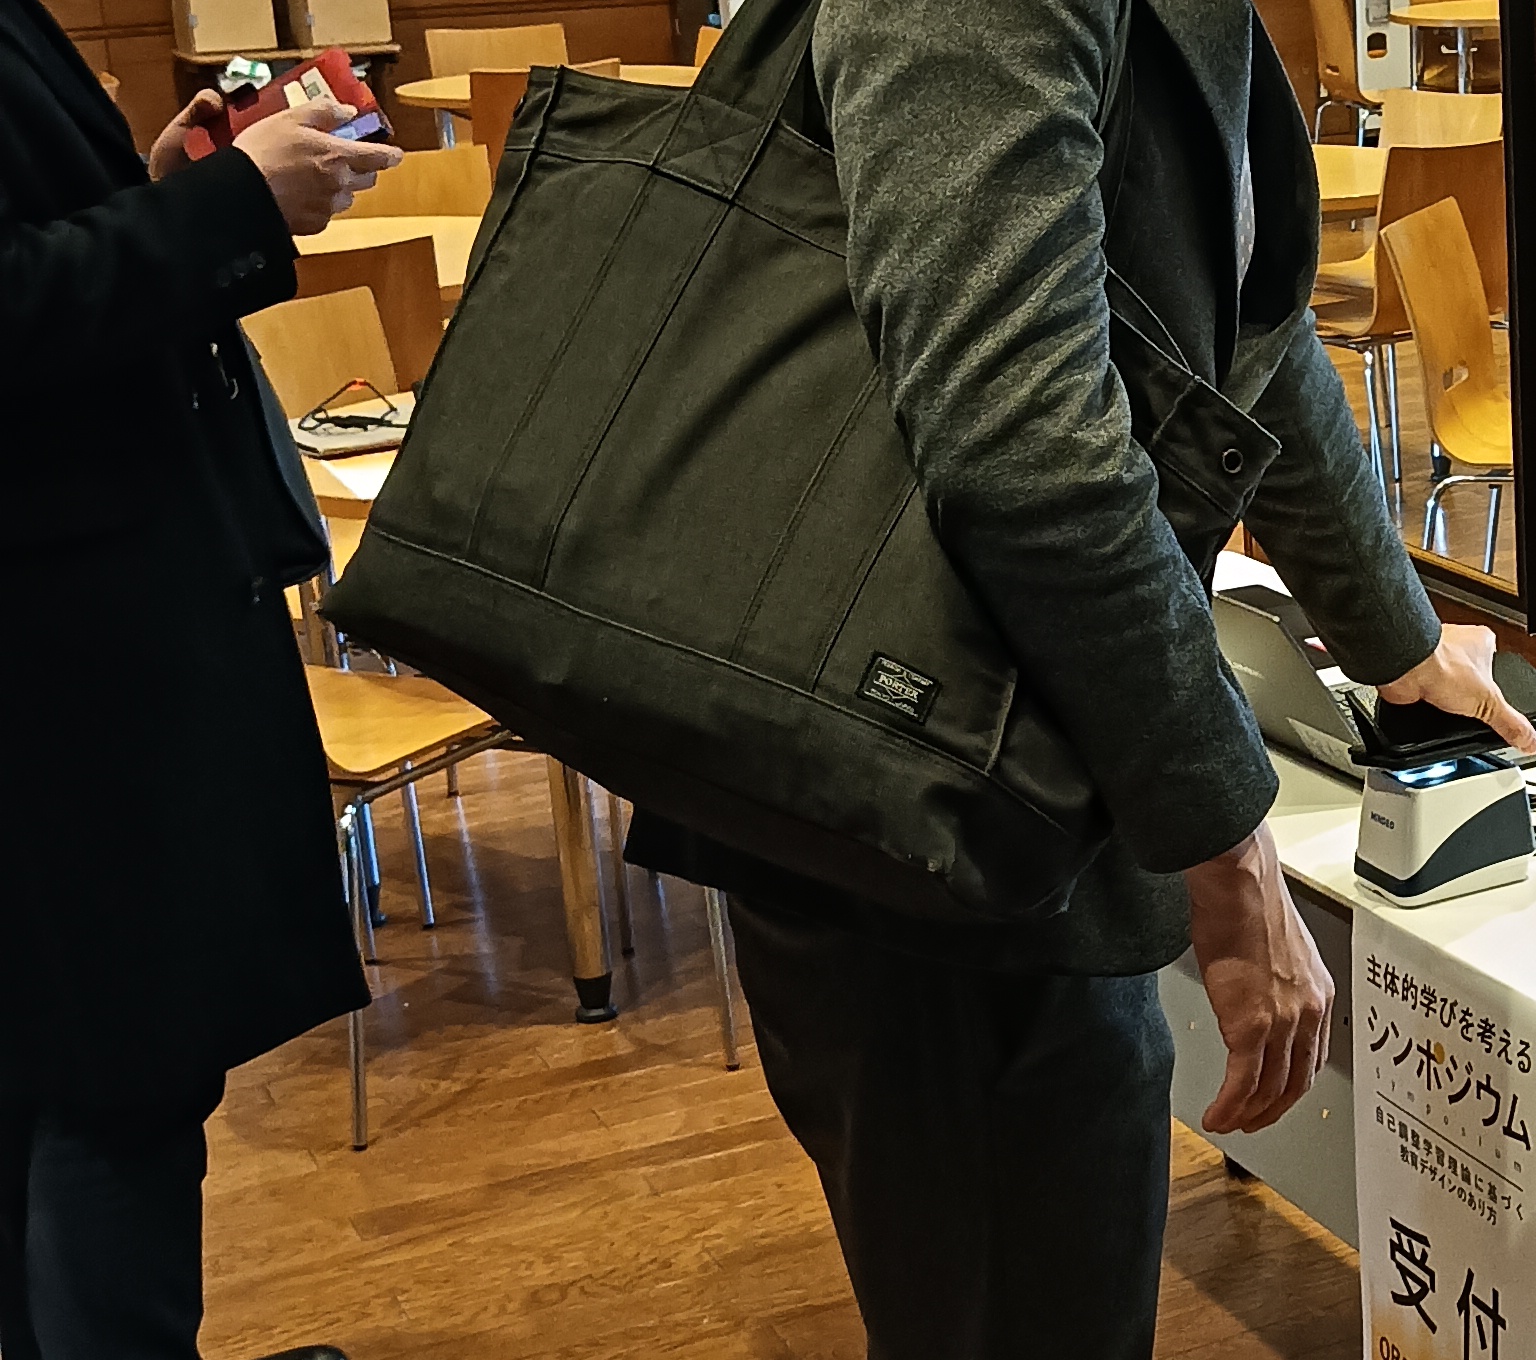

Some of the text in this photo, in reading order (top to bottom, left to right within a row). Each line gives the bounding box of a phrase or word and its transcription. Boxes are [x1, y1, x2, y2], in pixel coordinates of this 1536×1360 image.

[879, 674, 919, 700] PORTER
[1366, 953, 1532, 1074] 主体的学びを考える
[1367, 1005, 1532, 1152] シンポジウム
[1400, 1143, 1498, 1226] 教育デザインのあり方
